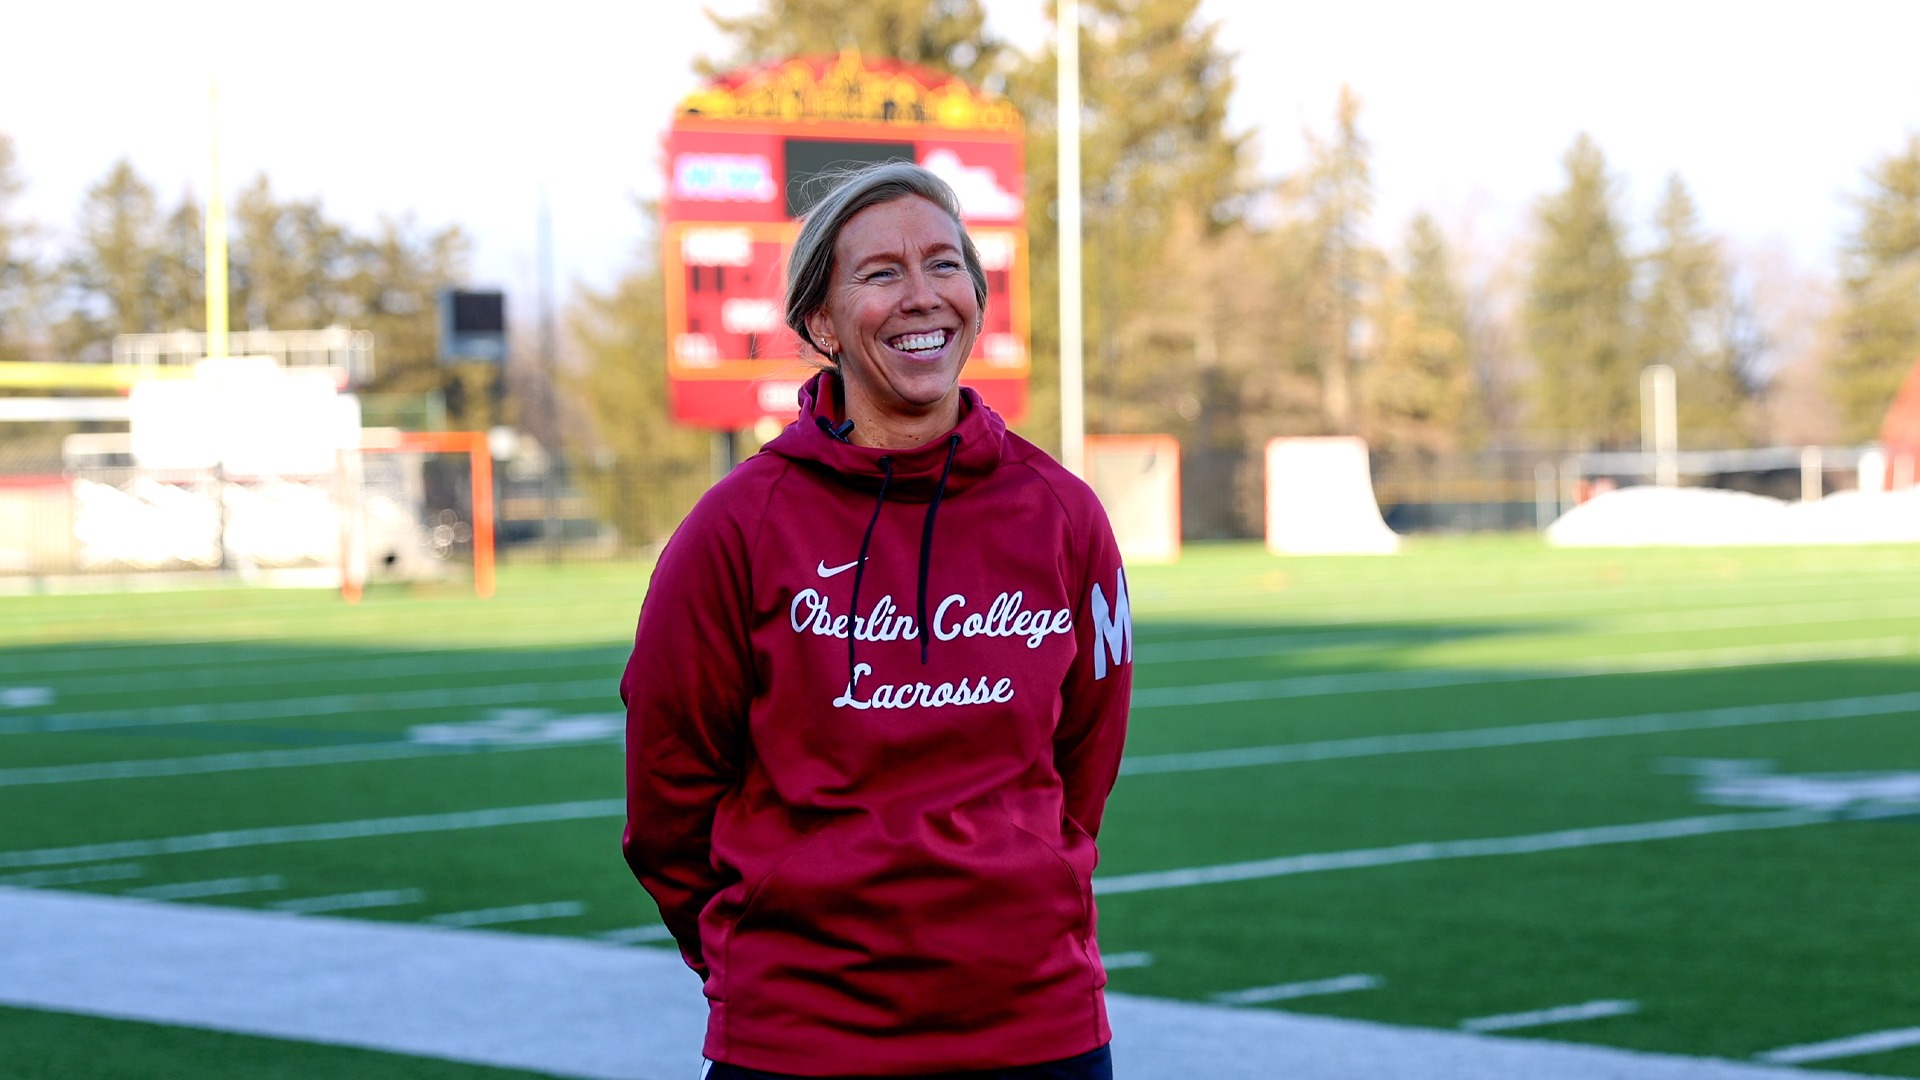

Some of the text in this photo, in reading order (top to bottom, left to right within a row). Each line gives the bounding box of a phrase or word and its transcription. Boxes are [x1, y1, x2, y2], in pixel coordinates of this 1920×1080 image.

[790, 588, 1073, 649] Oberlin College
[833, 662, 1015, 710] Lacrosse
